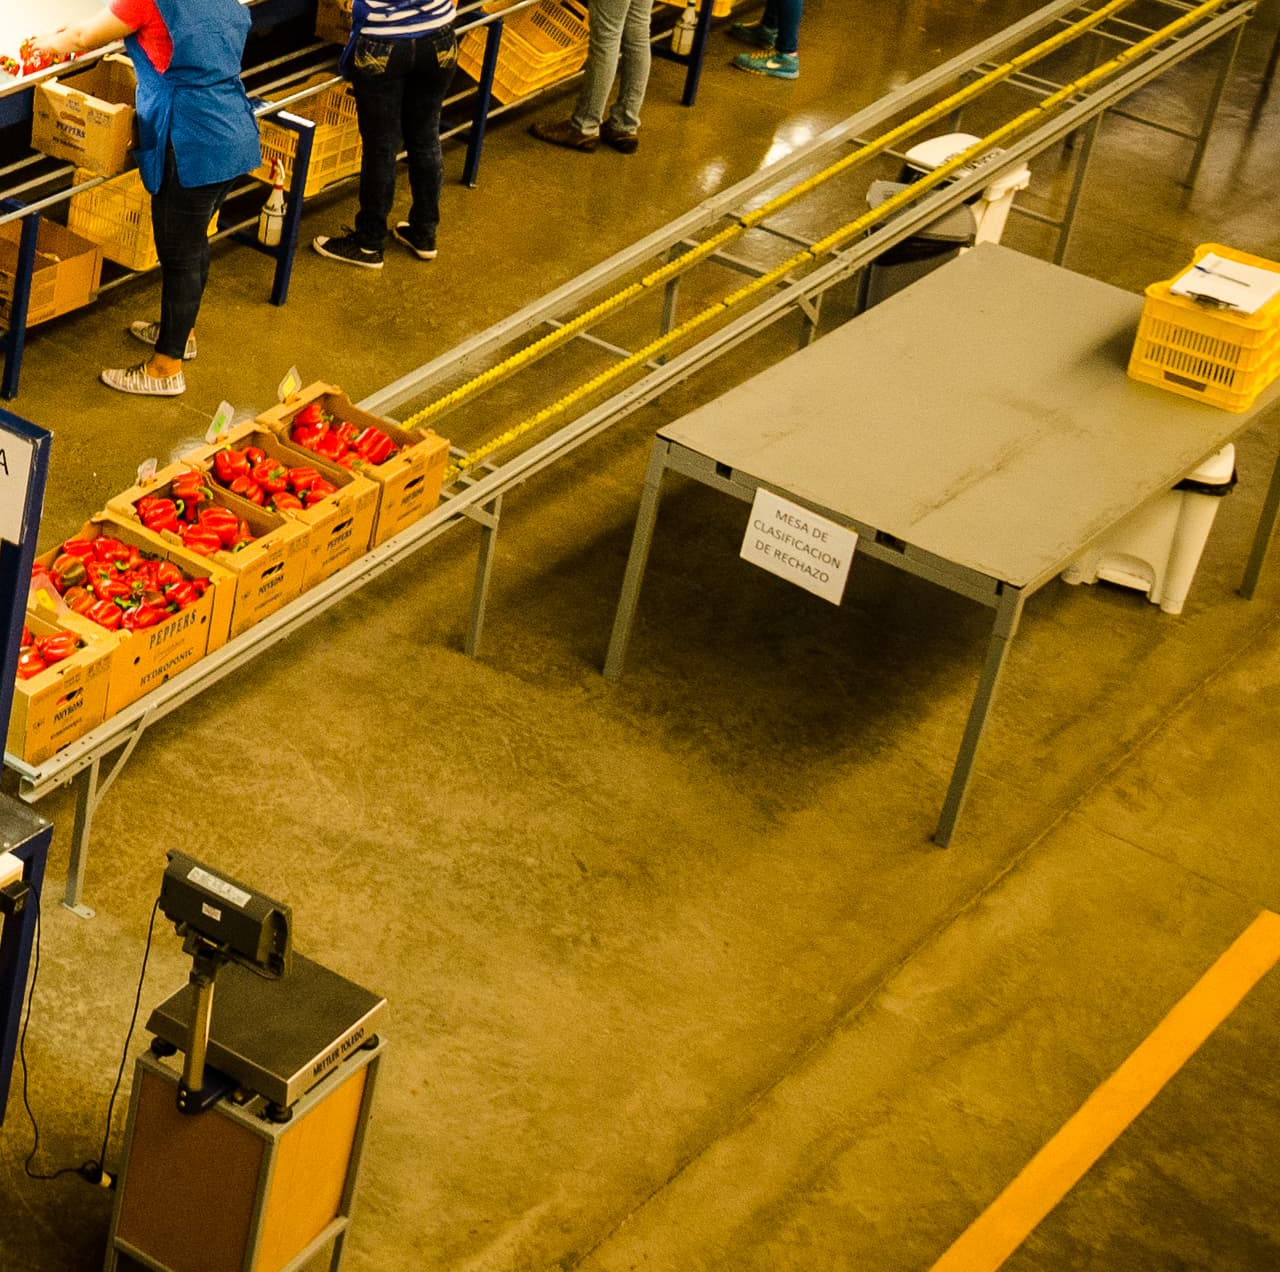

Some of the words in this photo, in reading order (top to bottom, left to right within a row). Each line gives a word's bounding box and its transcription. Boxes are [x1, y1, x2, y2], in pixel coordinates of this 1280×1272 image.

[753, 520, 841, 569] CLASIFICACION
[775, 510, 808, 534] MESA
[812, 528, 829, 543] DE
[755, 540, 771, 554] DE
[774, 549, 830, 583] RECHAZO
[149, 609, 197, 649] PEPPERS
[140, 646, 194, 686] HYDROPONIC
